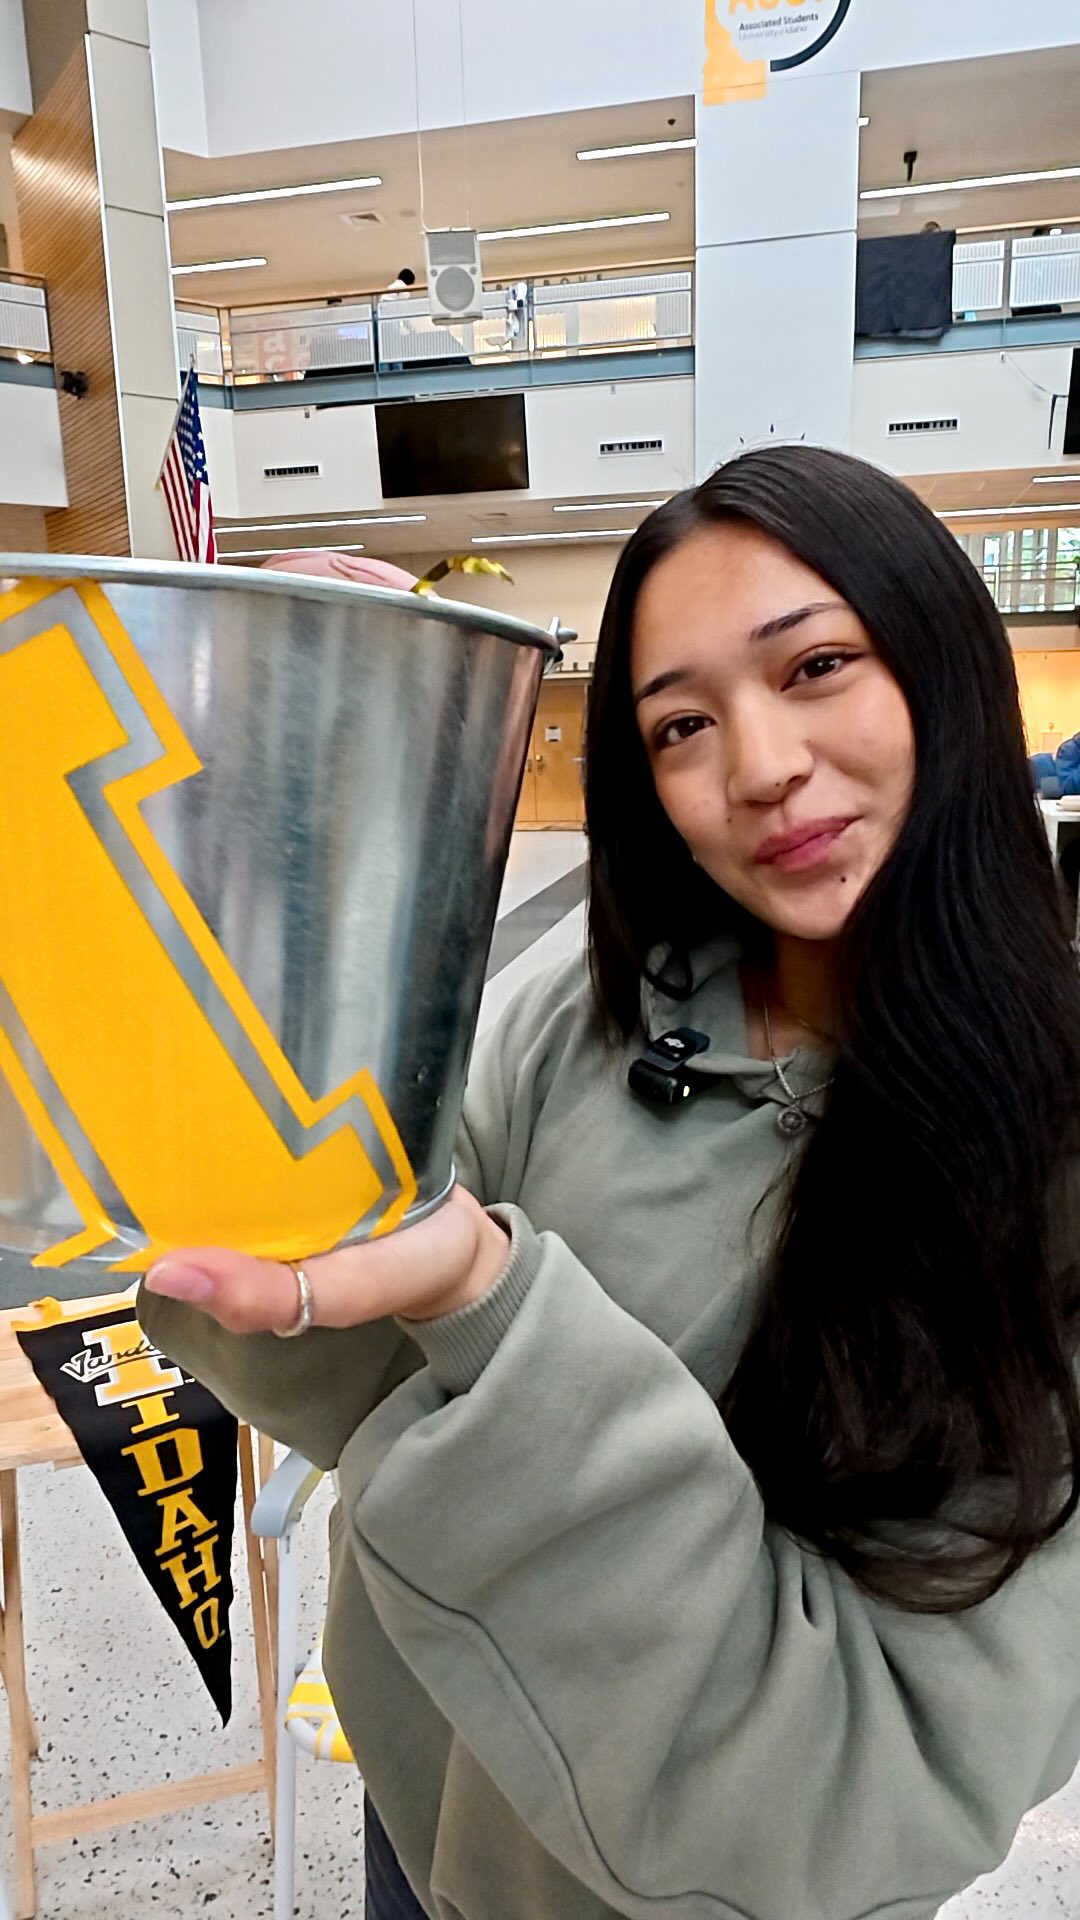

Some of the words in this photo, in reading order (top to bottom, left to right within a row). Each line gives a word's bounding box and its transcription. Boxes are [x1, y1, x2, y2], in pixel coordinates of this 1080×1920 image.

[739, 18, 781, 31] Associated
[783, 13, 819, 25] Students
[121, 1391, 222, 1649] IDAHO
